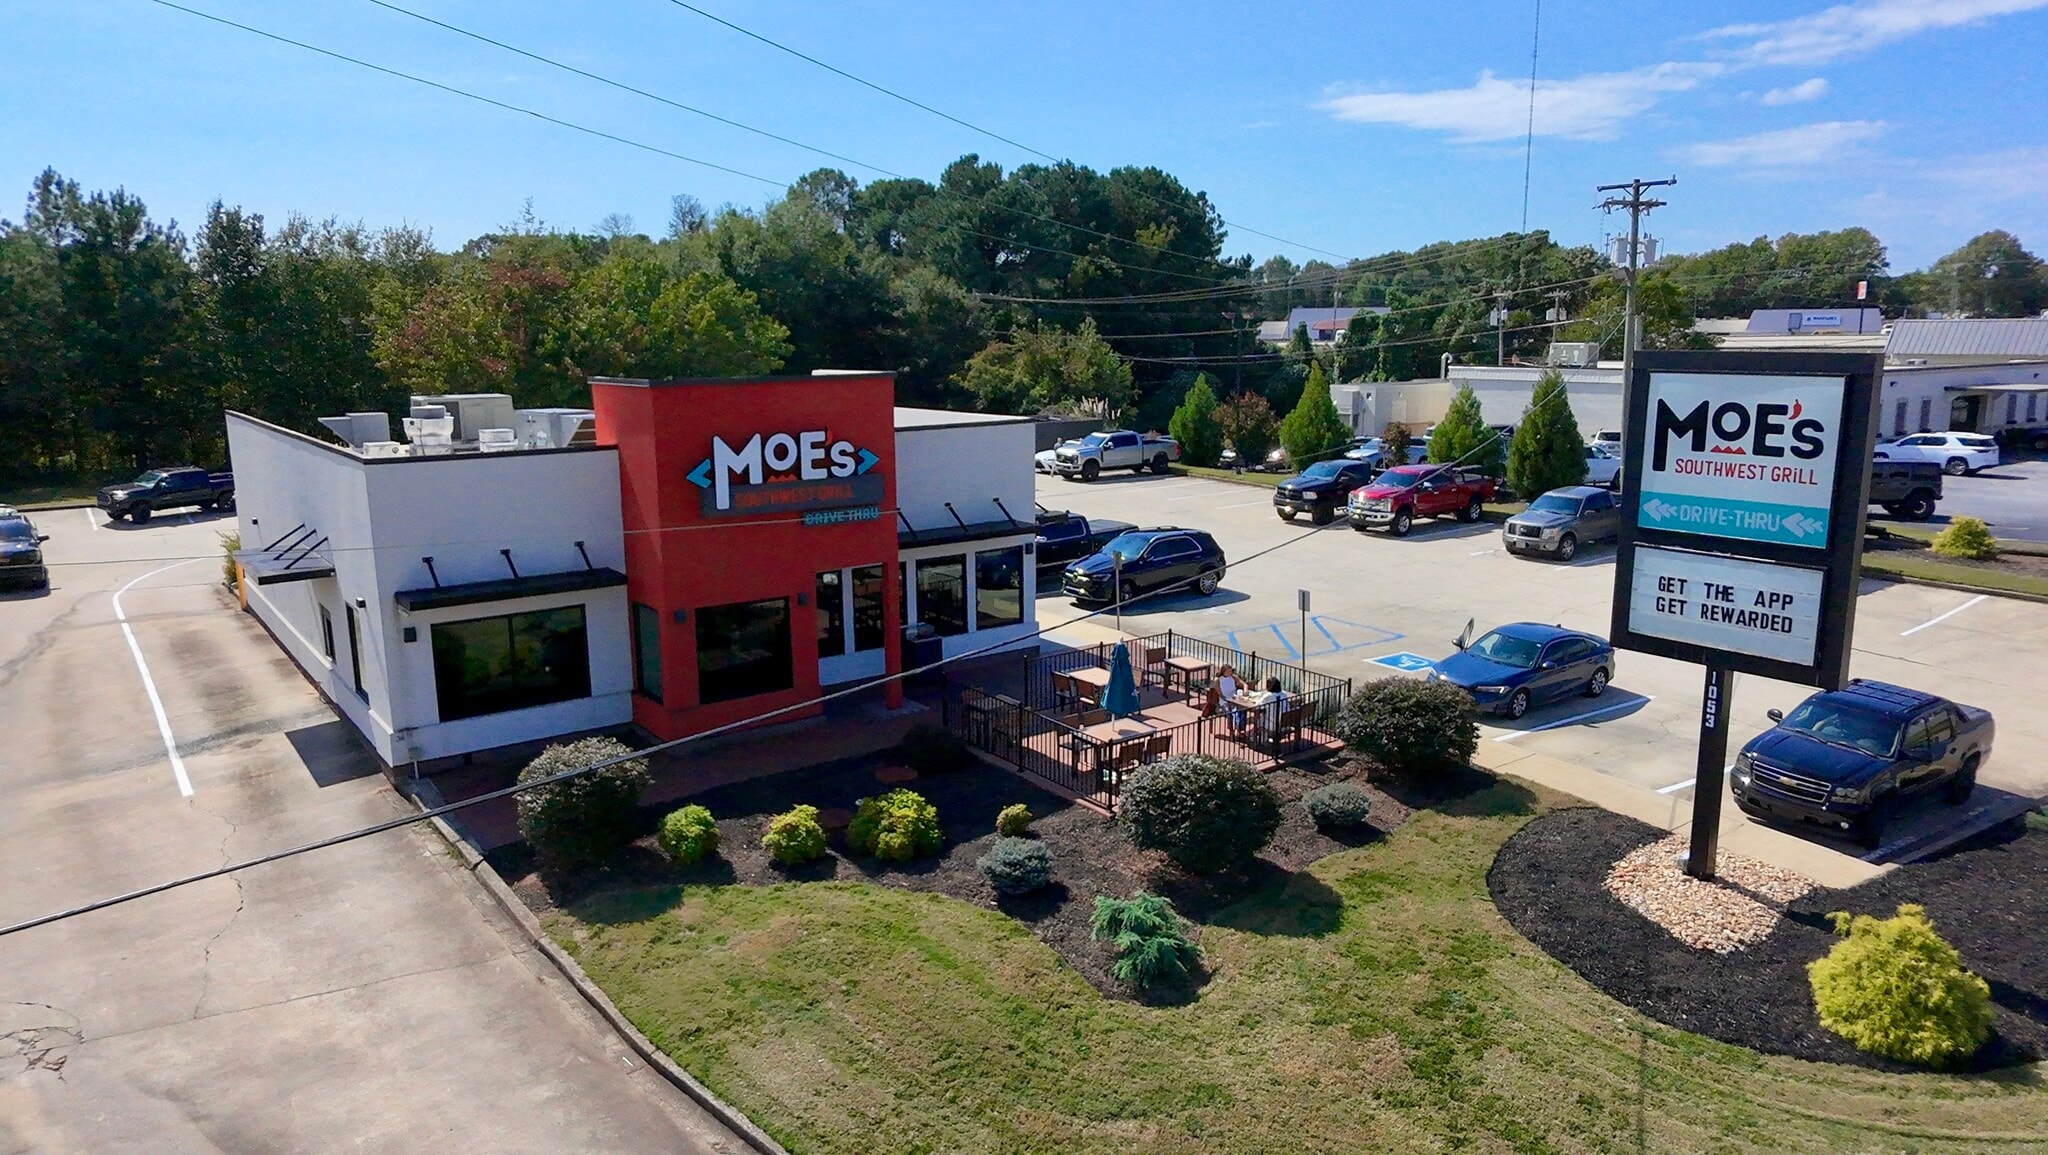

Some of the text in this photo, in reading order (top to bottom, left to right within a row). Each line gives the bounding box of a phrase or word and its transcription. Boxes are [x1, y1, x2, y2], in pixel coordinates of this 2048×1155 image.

[1652, 398, 1825, 472] MOE'S
[713, 427, 856, 510] MOE'S
[1675, 459, 1768, 481] SOUTHWEST
[1679, 504, 1781, 533] DRIVE-THRU
[1658, 576, 1794, 611] GET THE APP
[1656, 597, 1793, 634] GET REWARDED
[1705, 671, 1717, 728] 1053
